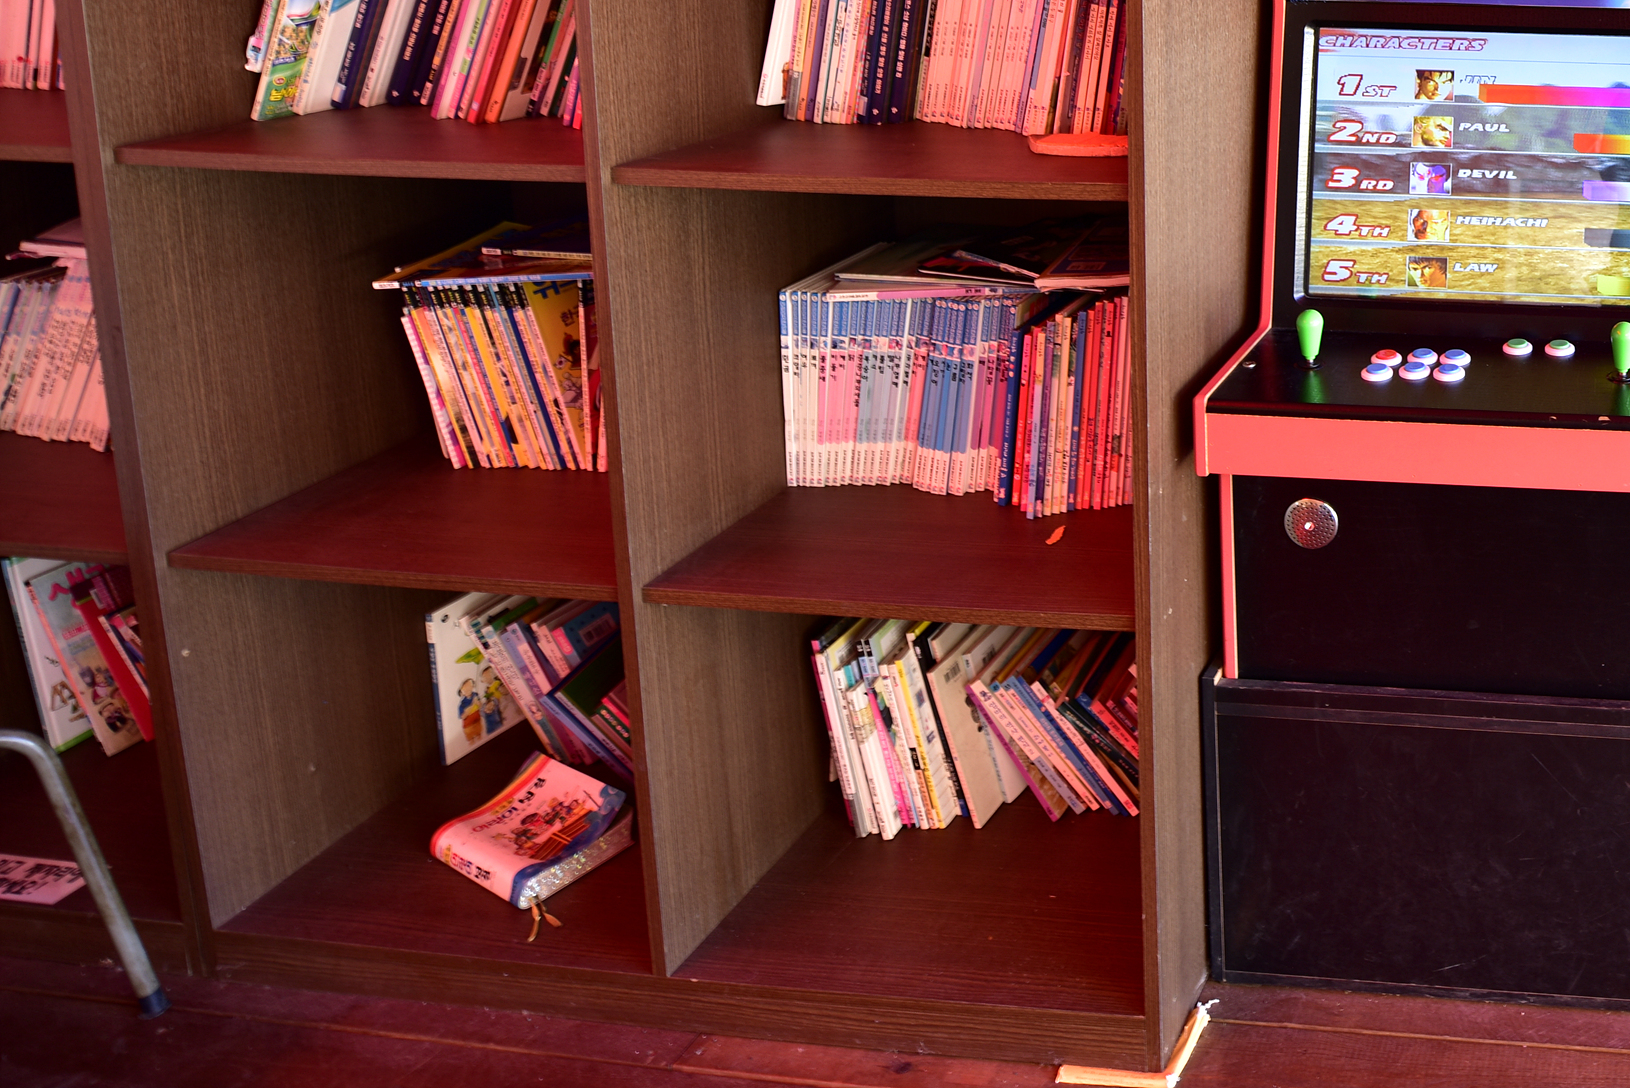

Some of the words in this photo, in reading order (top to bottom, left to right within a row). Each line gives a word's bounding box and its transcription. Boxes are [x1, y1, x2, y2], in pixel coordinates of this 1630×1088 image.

[1319, 34, 1488, 51] CHARACTERS
[1337, 73, 1397, 98] 1ST
[1327, 119, 1398, 144] 2ND
[1459, 122, 1510, 133] PAUL
[1325, 166, 1395, 191] 3RD
[1458, 169, 1517, 180] DEVIL
[1324, 213, 1391, 238] 4TH
[1455, 216, 1549, 228] HEIHACHI
[1322, 258, 1389, 284] 5TH
[1453, 263, 1498, 273] LAW
